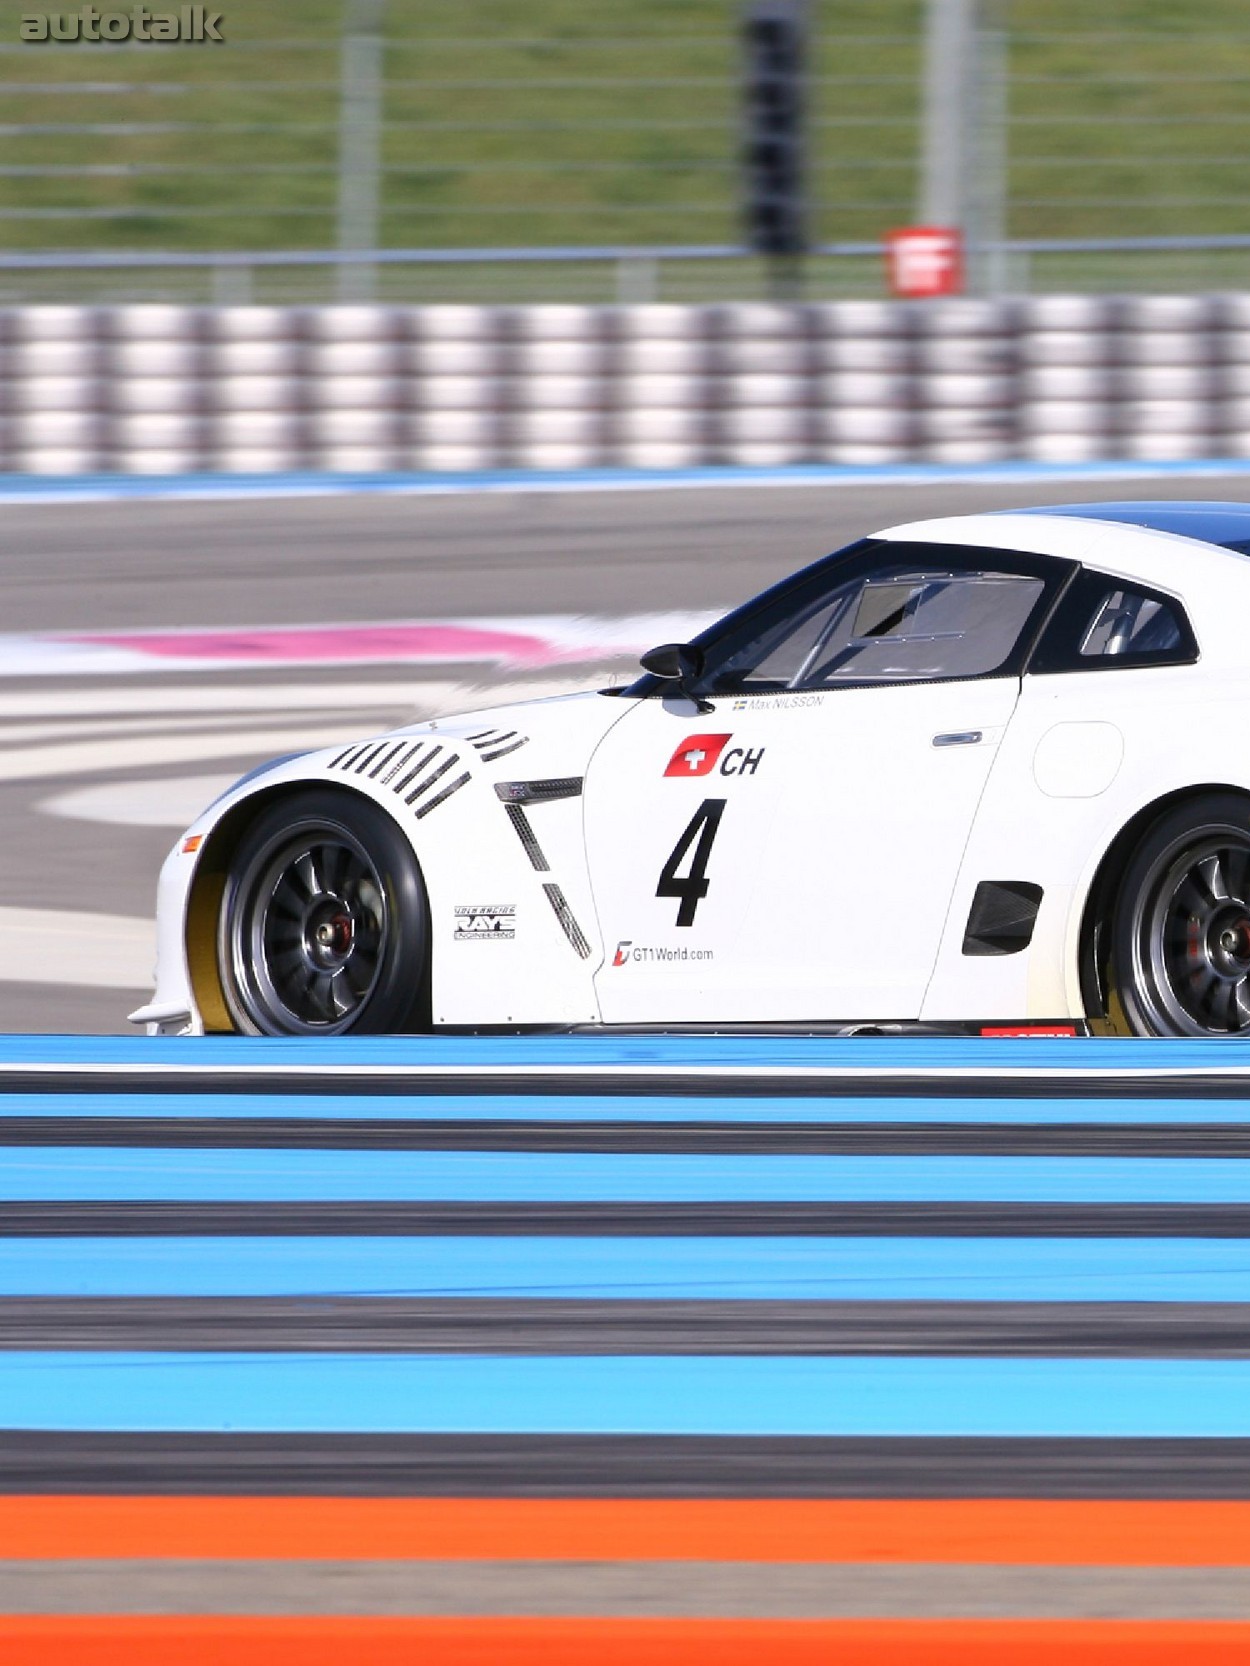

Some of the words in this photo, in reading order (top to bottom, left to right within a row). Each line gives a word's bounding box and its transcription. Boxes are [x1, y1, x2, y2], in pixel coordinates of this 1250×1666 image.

[749, 699, 771, 711] Max
[772, 695, 825, 710] NILSSON
[719, 747, 766, 777] CH
[655, 798, 728, 927] 4
[633, 946, 714, 962] GT1World.com
